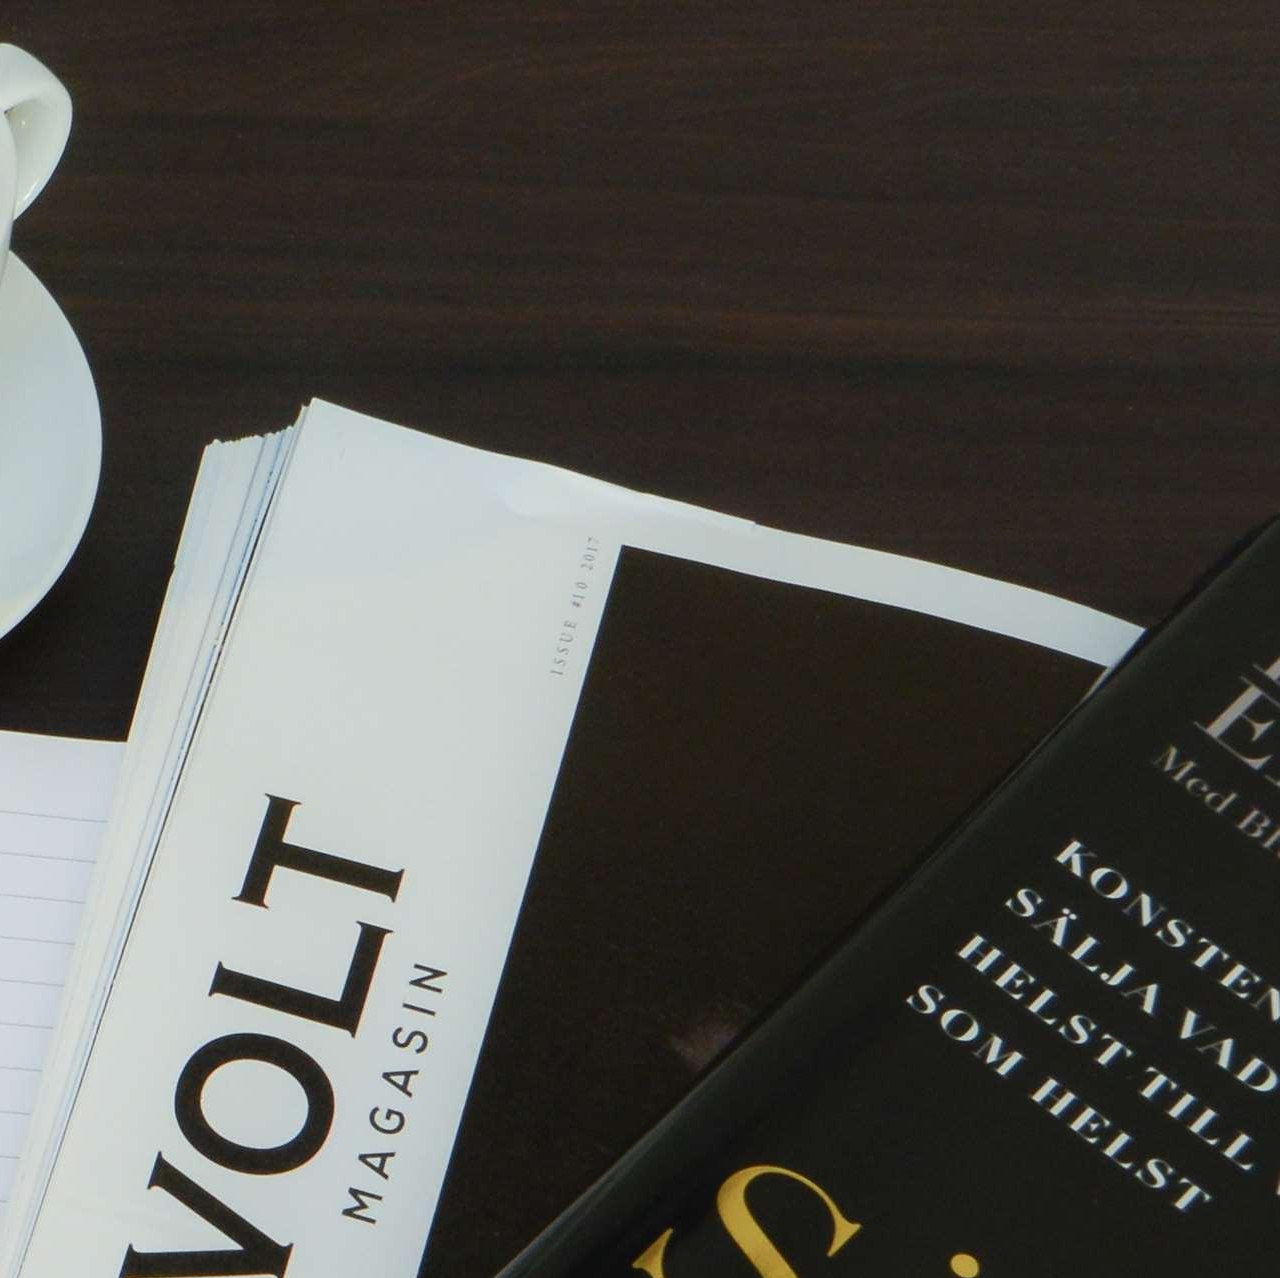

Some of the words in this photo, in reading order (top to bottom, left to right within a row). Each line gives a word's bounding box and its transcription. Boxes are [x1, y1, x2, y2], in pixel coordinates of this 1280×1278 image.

[550, 620, 577, 676] ISSUE
[580, 535, 599, 571] 2017
[1152, 745, 1238, 814] Med
[342, 963, 448, 1225] MAGASIN
[906, 983, 1026, 1080] SOM
[1030, 1076, 1213, 1213] HELST
[956, 932, 1133, 1068] HELST
[1140, 1066, 1254, 1171] TILL
[1005, 887, 1160, 1017] SÄLJA
[1179, 1008, 1278, 1093] VAD
